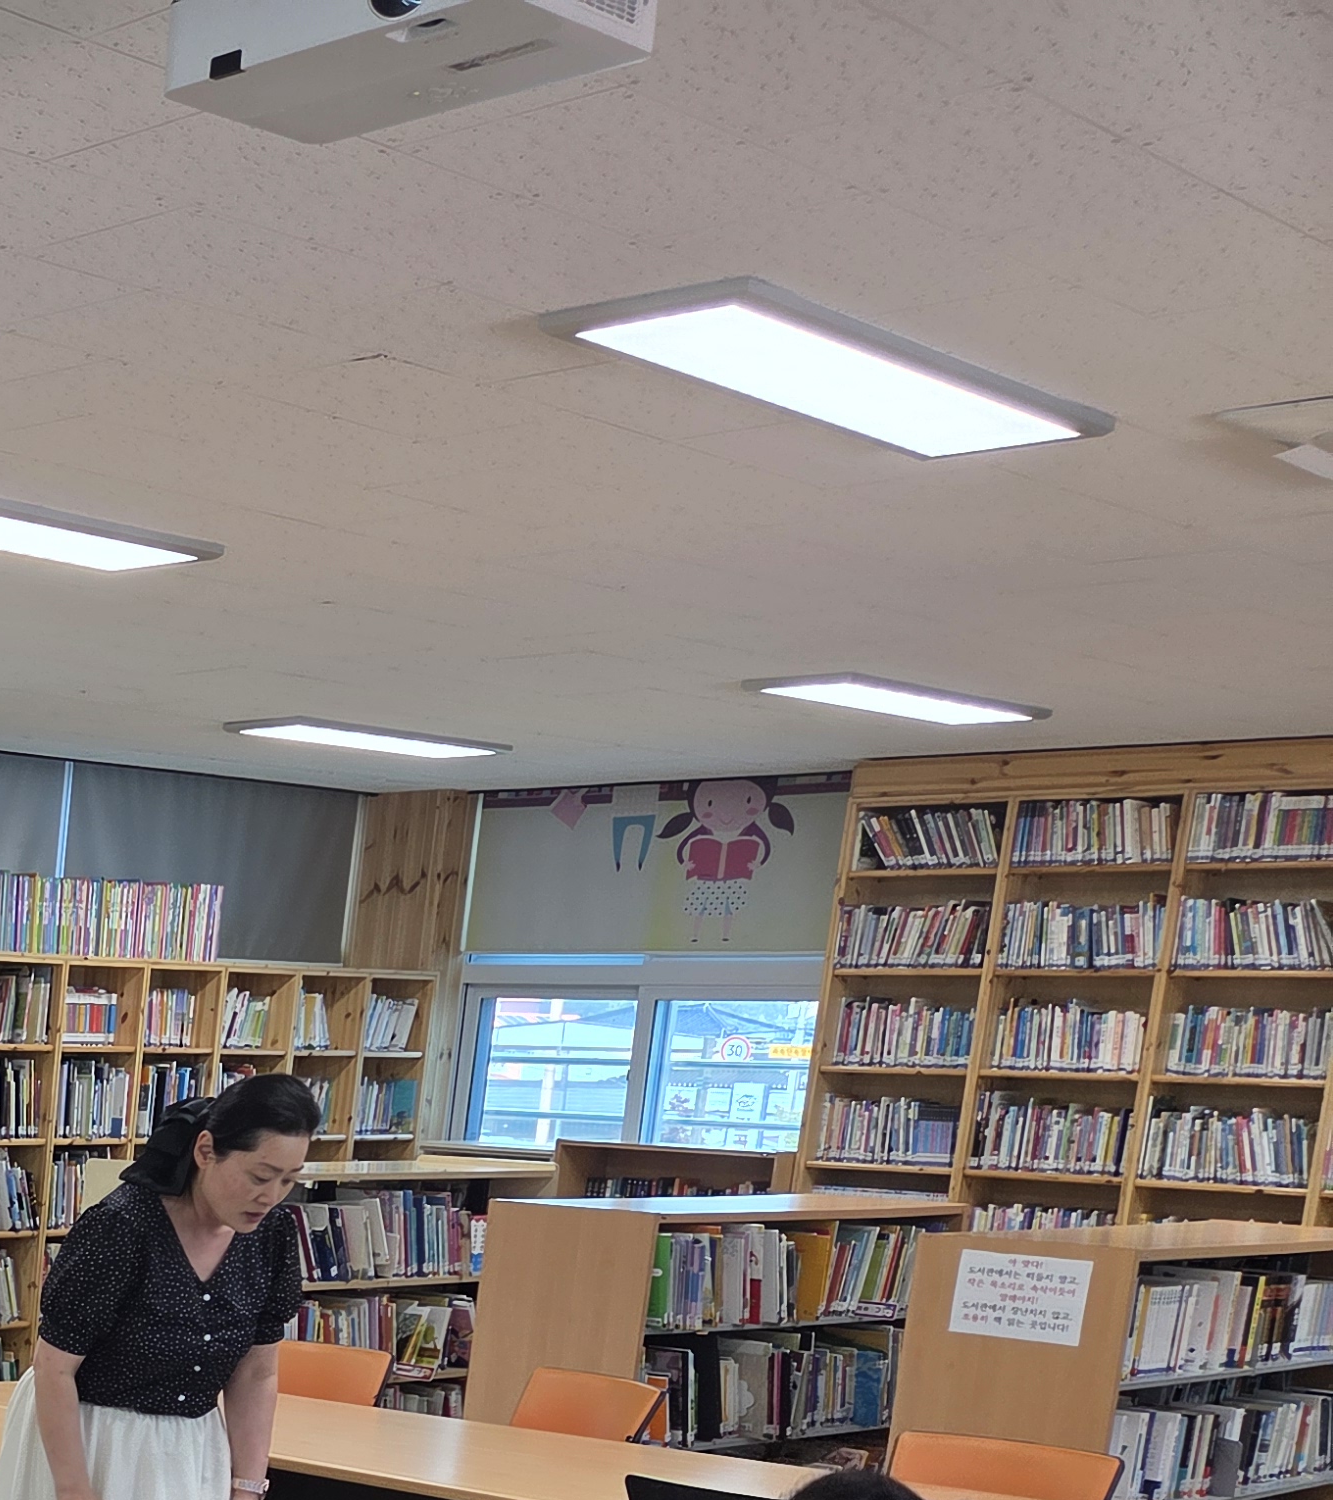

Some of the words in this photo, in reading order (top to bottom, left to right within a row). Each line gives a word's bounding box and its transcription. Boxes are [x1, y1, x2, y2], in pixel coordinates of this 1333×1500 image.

[726, 1044, 743, 1057] 30
[967, 1266, 1022, 1280] 도서관에서는
[967, 1277, 985, 1288] 작은
[990, 1280, 1025, 1291] 목소리로
[1030, 1284, 1076, 1298] 속삭이듯이
[961, 1301, 1007, 1314] 도서관에서
[961, 1313, 989, 1324] 조용히
[1029, 1320, 1070, 1333] 곳입니다!
